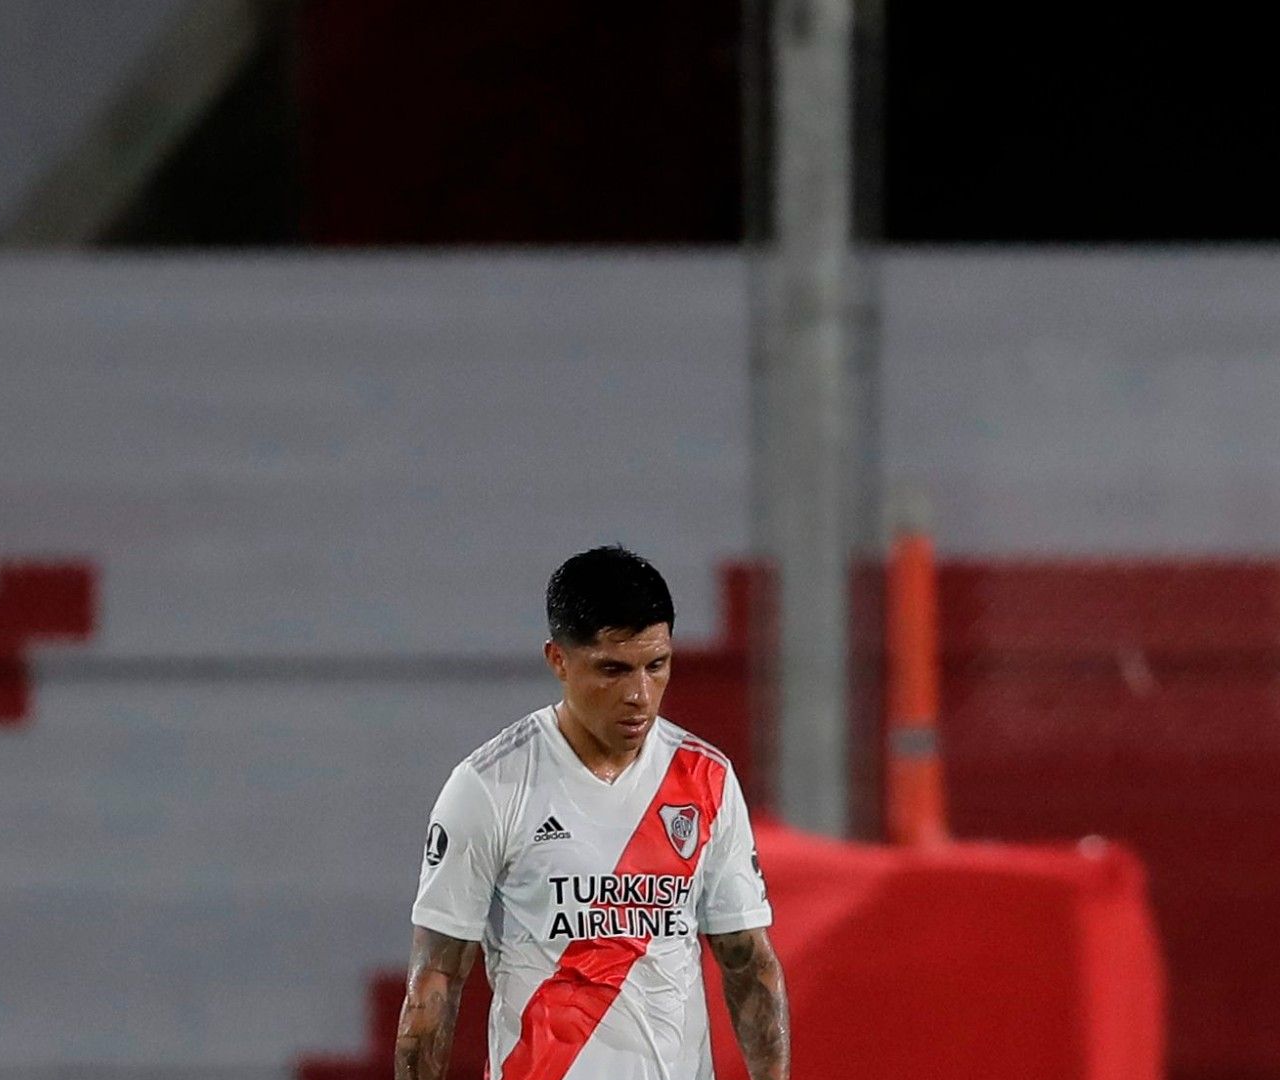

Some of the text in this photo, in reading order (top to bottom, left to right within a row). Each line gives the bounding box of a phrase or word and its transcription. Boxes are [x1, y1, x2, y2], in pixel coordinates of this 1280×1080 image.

[534, 831, 571, 842] adidas
[548, 875, 695, 906] TURKISH
[548, 910, 690, 940] AIRLINES
